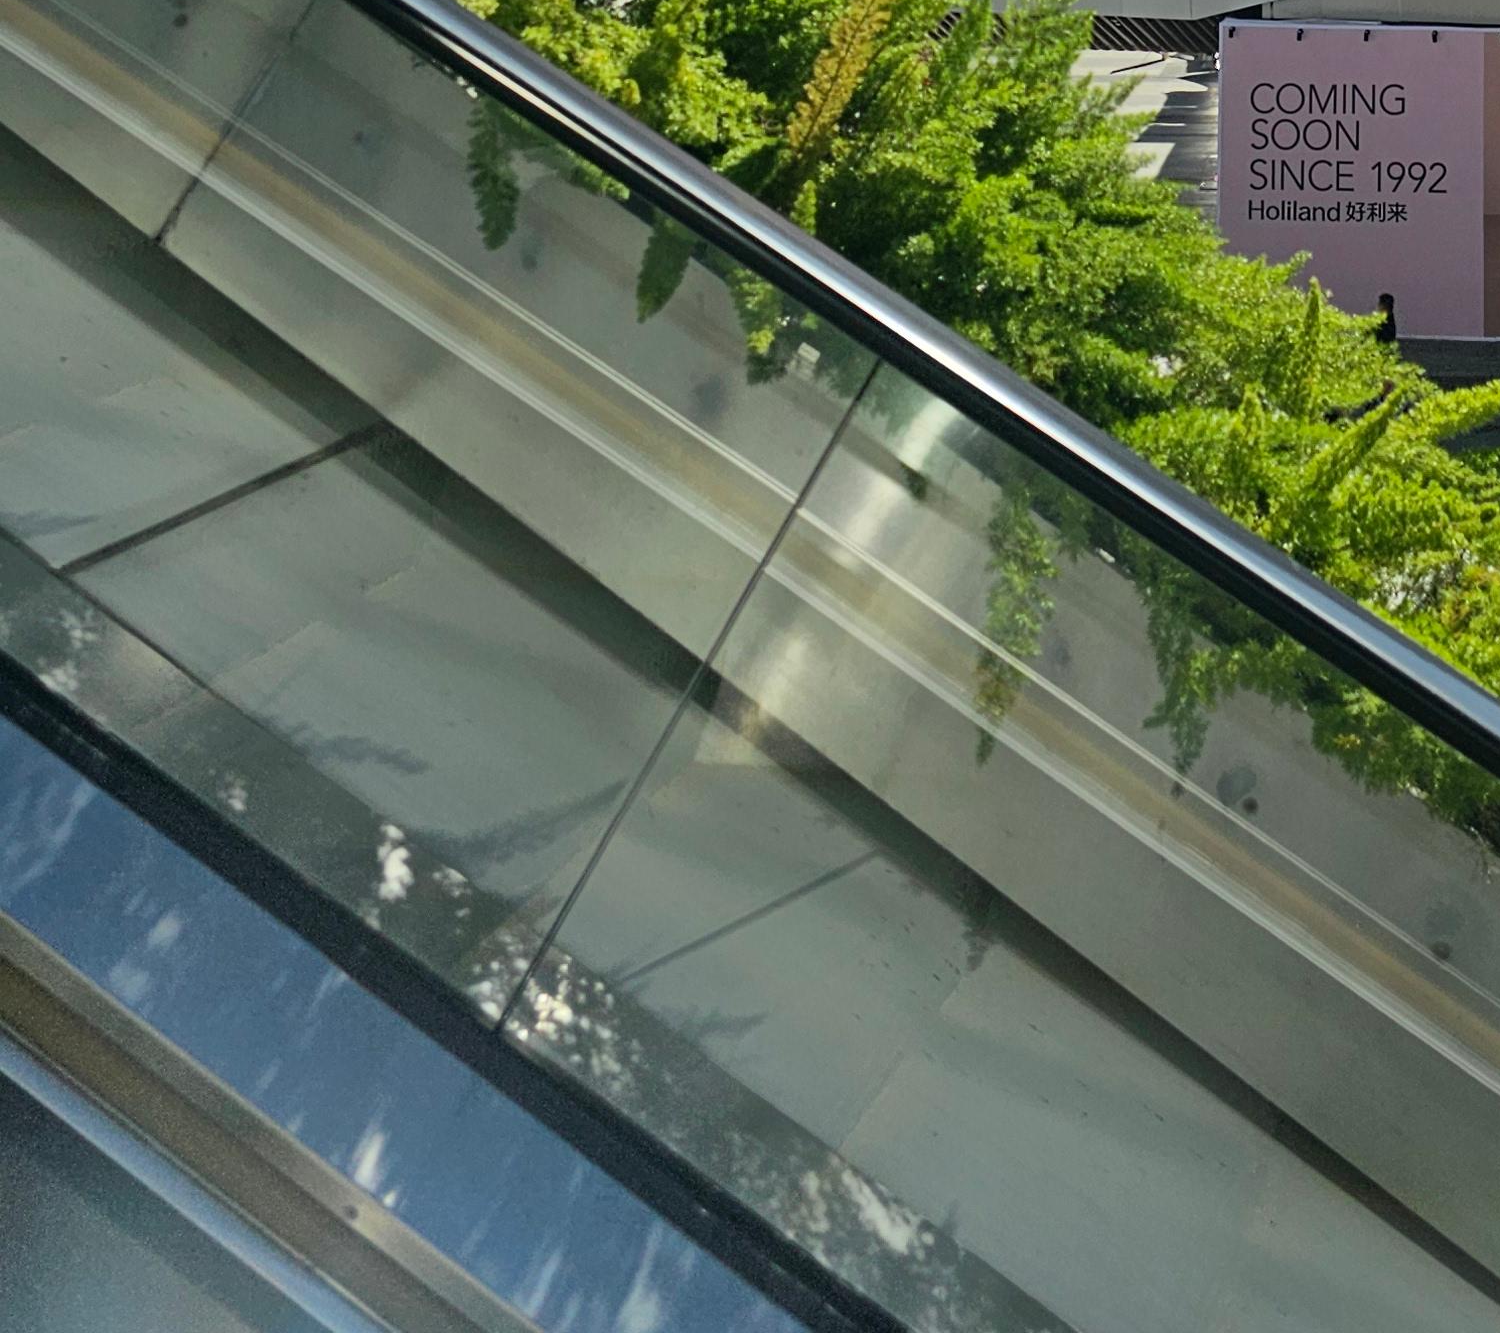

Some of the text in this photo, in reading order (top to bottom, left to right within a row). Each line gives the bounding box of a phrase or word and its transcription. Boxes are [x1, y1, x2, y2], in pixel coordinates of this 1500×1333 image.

[1249, 82, 1407, 117] COMING
[1249, 118, 1361, 152] SOON
[1248, 159, 1448, 194] SINCE 1992
[1247, 199, 1408, 223] Holiland 好利来
